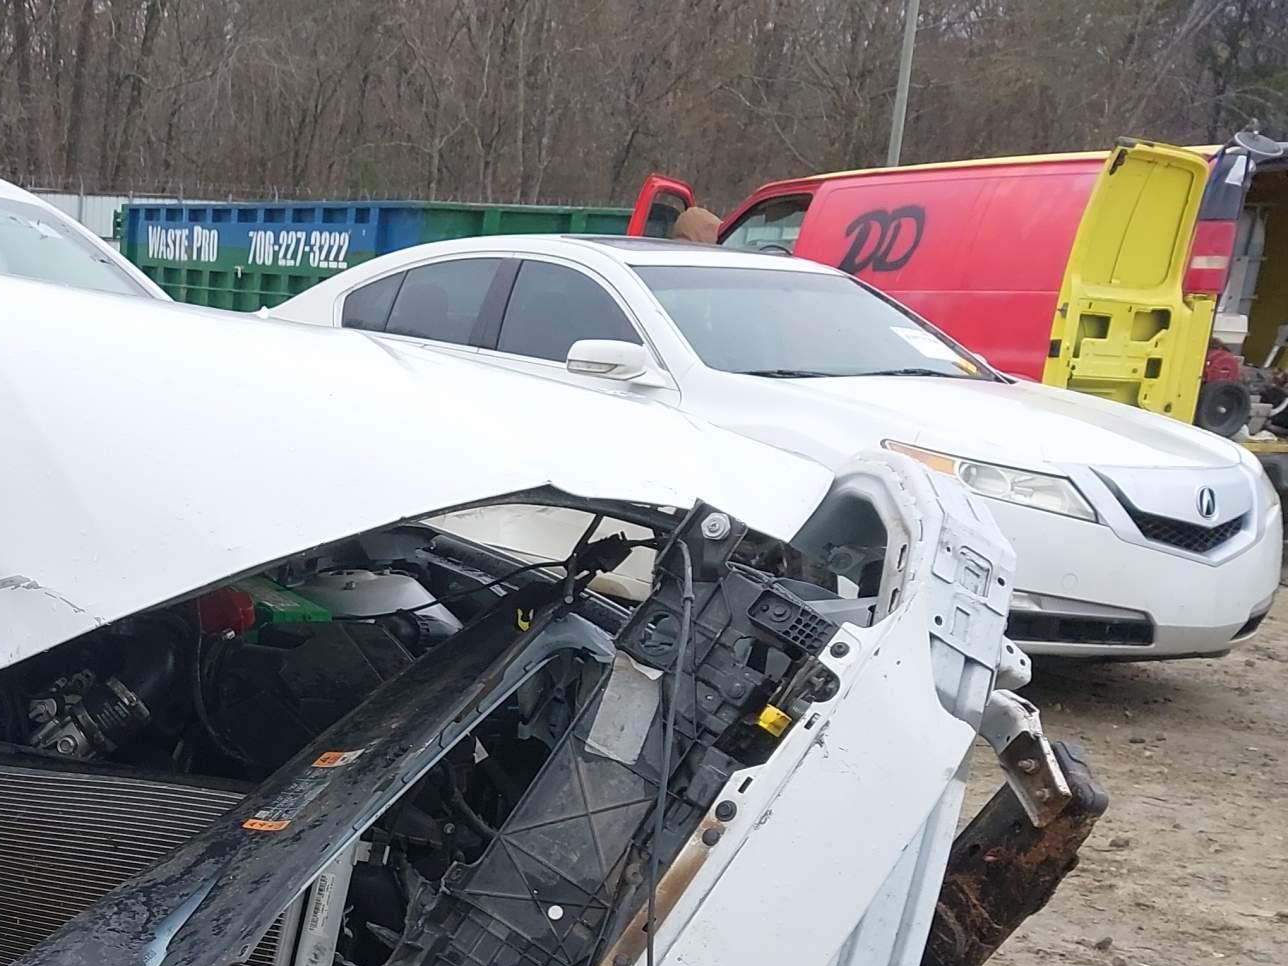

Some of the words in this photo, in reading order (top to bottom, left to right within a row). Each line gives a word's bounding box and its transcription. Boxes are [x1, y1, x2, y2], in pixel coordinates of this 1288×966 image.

[148, 224, 189, 261] WASTE
[192, 224, 218, 263] PRO
[247, 230, 350, 269] 706-227-3222
